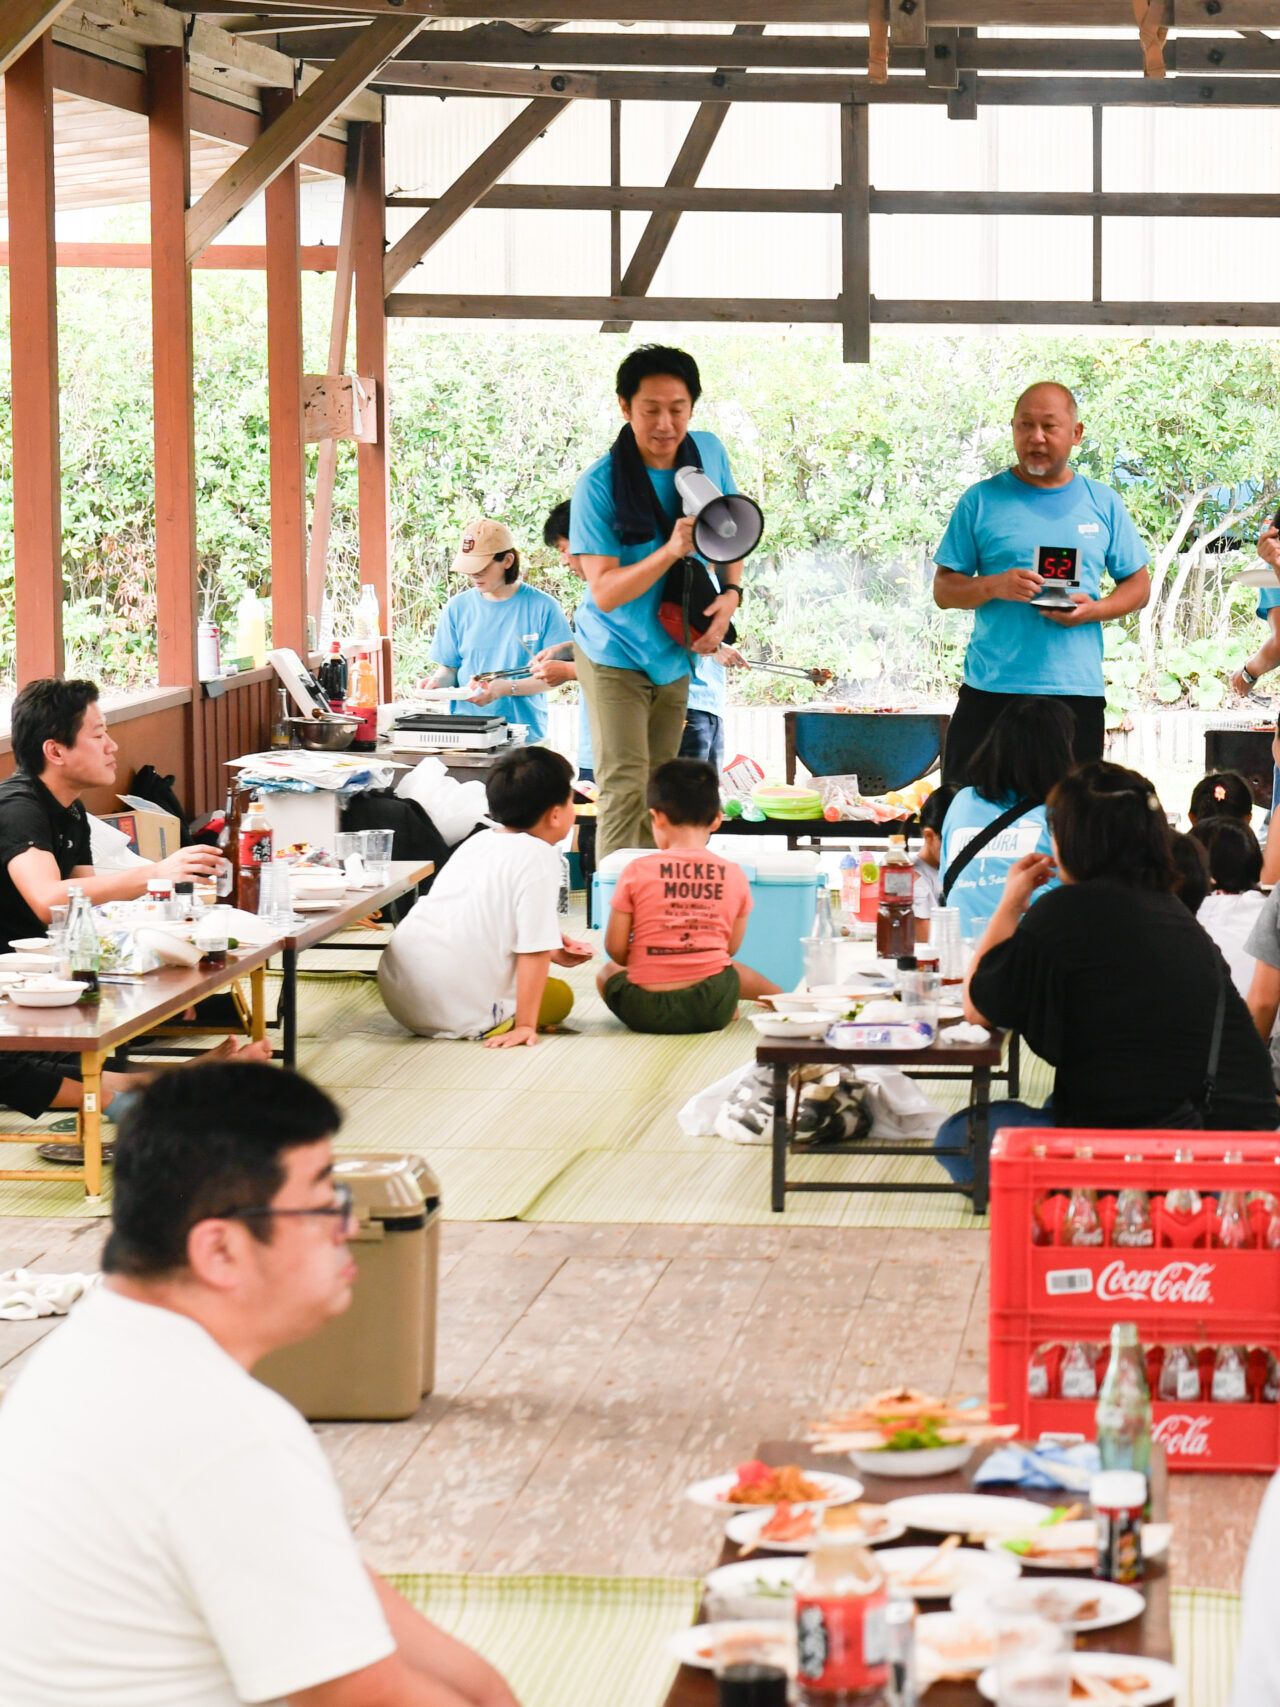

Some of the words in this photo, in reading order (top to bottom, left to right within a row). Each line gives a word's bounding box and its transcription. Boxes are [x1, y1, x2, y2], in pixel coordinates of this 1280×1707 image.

[1043, 557, 1072, 578] 52
[659, 862, 725, 880] MICKEY
[664, 882, 723, 900] MOUSE
[1096, 1260, 1216, 1303] Coca-Cola
